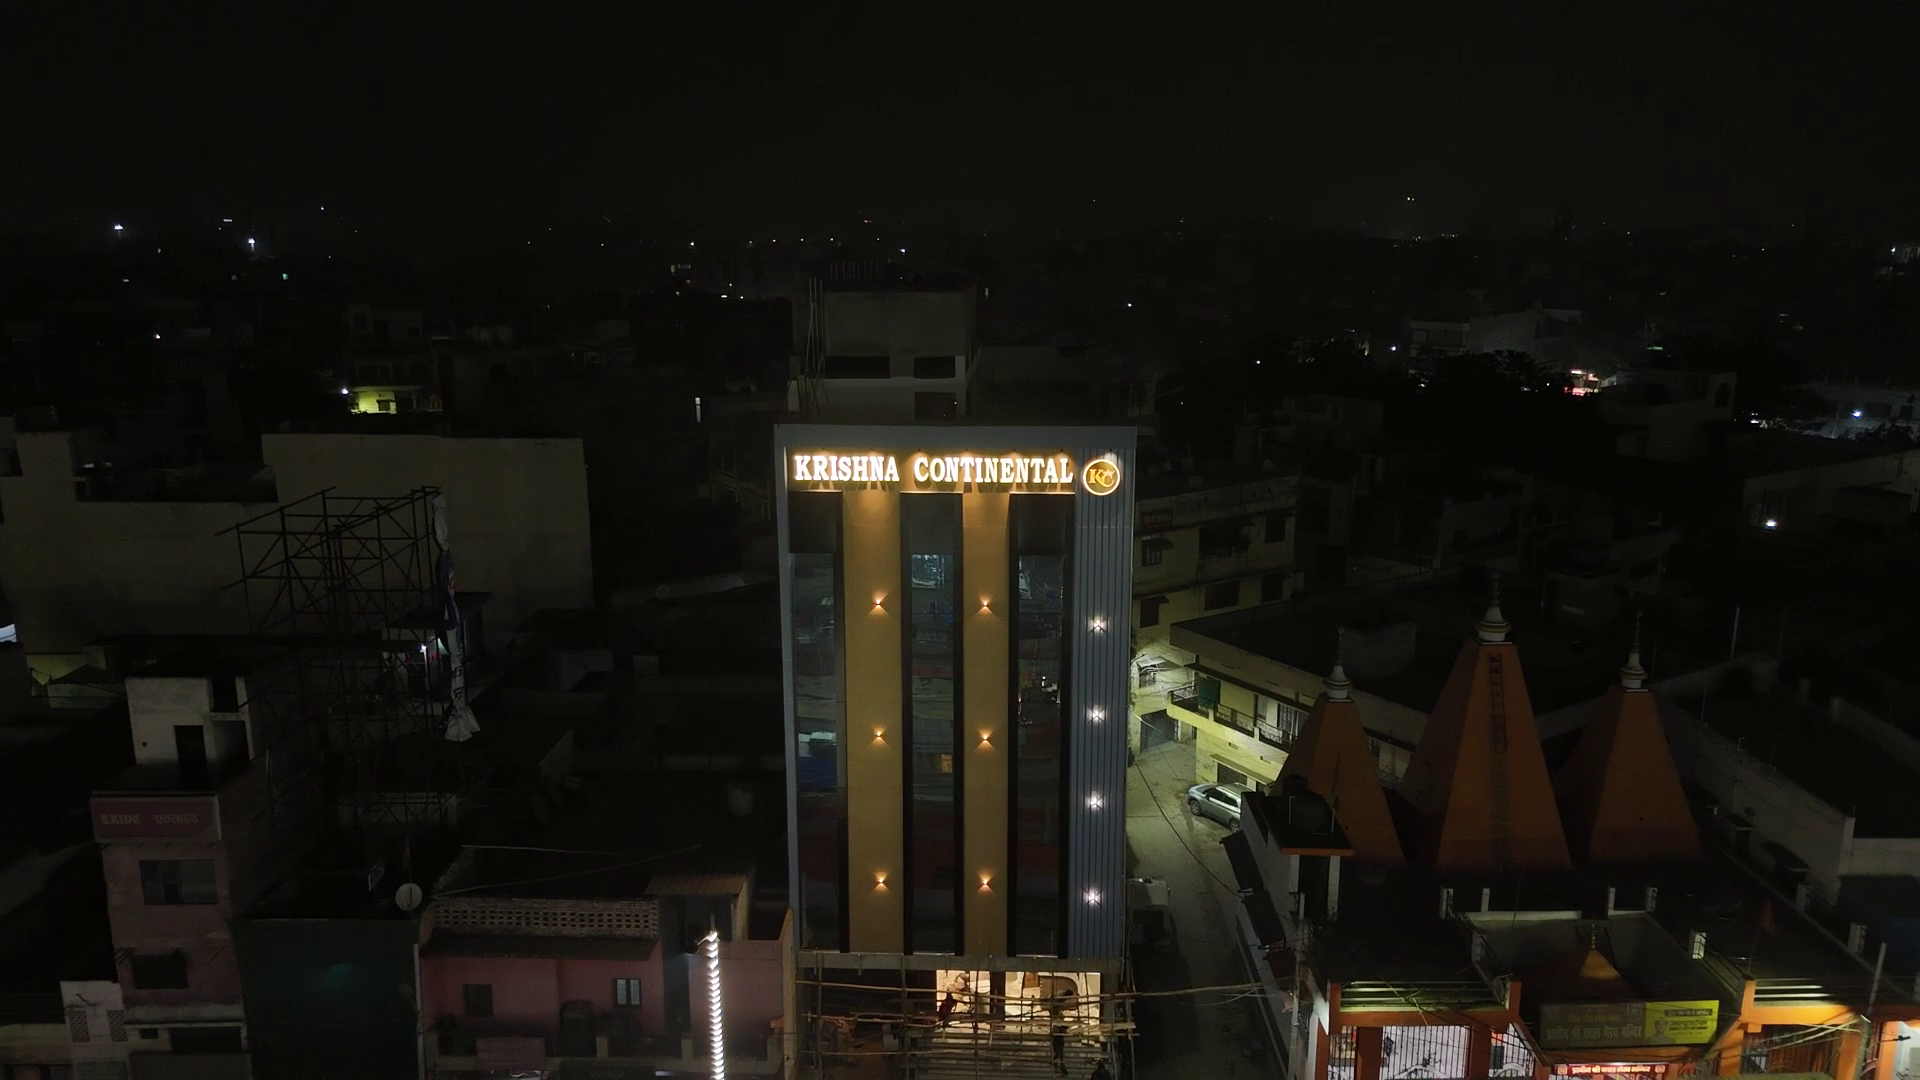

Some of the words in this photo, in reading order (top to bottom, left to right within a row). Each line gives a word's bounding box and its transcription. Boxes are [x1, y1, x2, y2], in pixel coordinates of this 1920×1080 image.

[794, 455, 900, 482] KRISHNA
[913, 456, 1074, 485] CONTINENTAL
[100, 814, 141, 825] EXIDE
